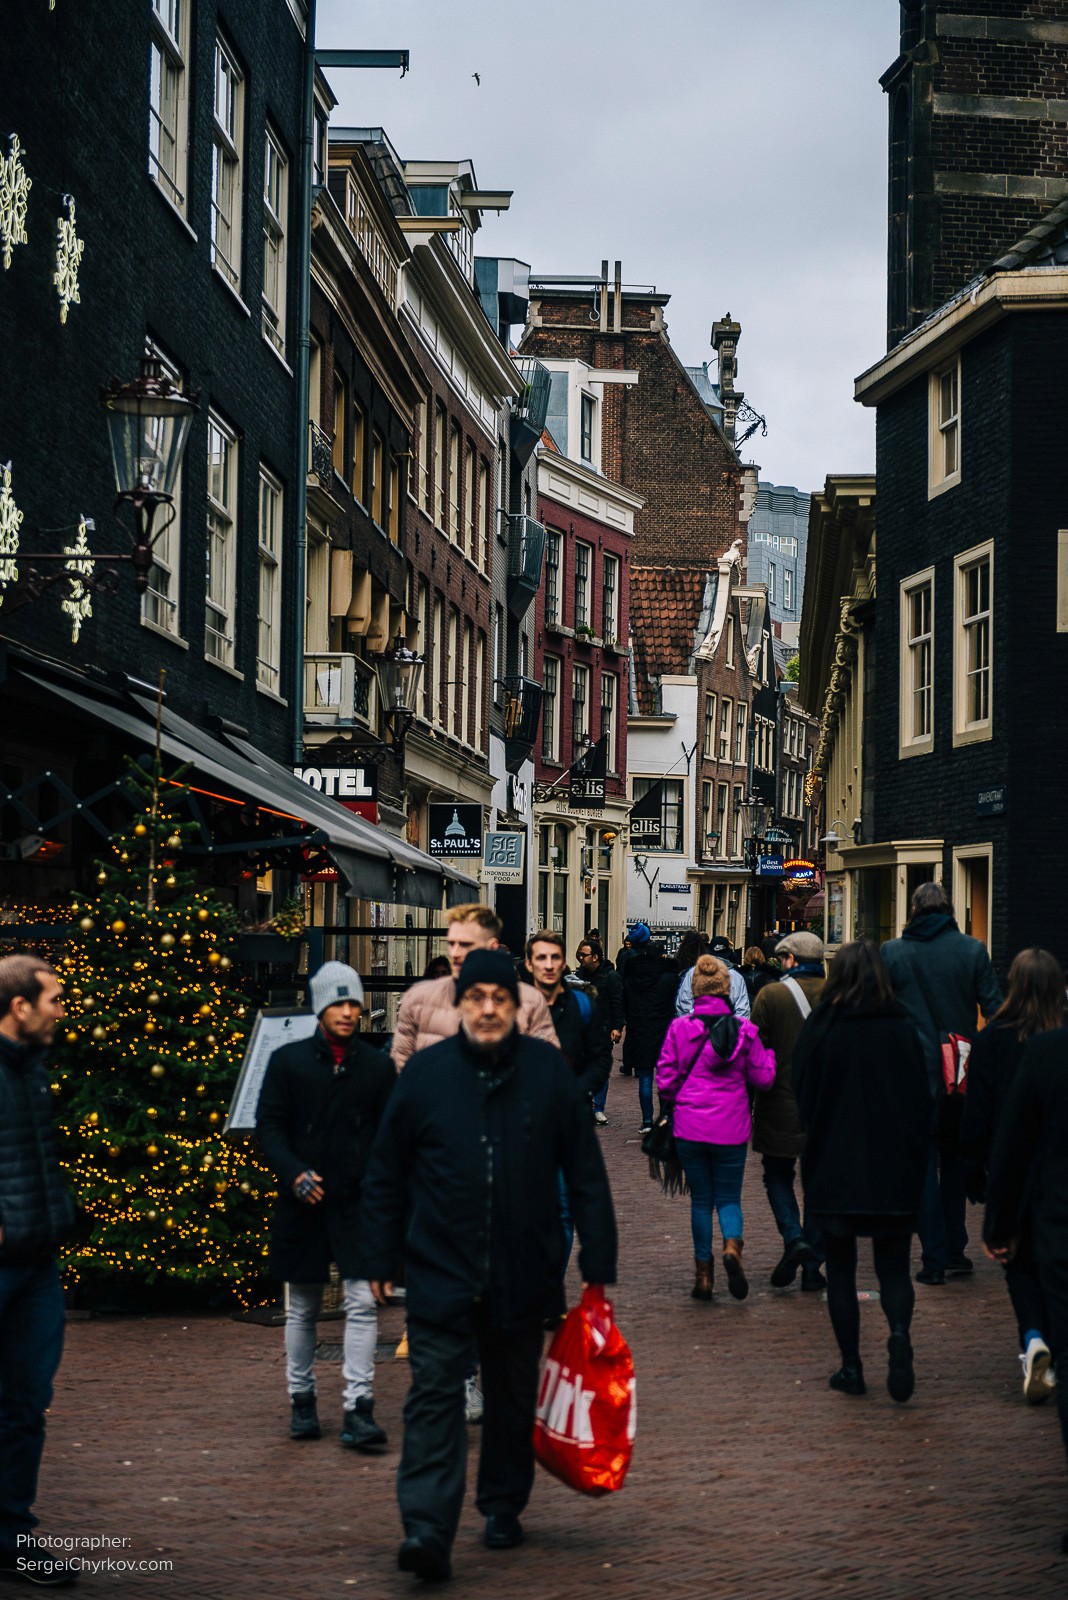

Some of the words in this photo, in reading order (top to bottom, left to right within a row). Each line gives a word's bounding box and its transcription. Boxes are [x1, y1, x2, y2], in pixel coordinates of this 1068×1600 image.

[294, 768, 373, 796] OTEL
[631, 820, 660, 833] ellis
[492, 837, 517, 851] SIE
[489, 851, 517, 865] JOE
